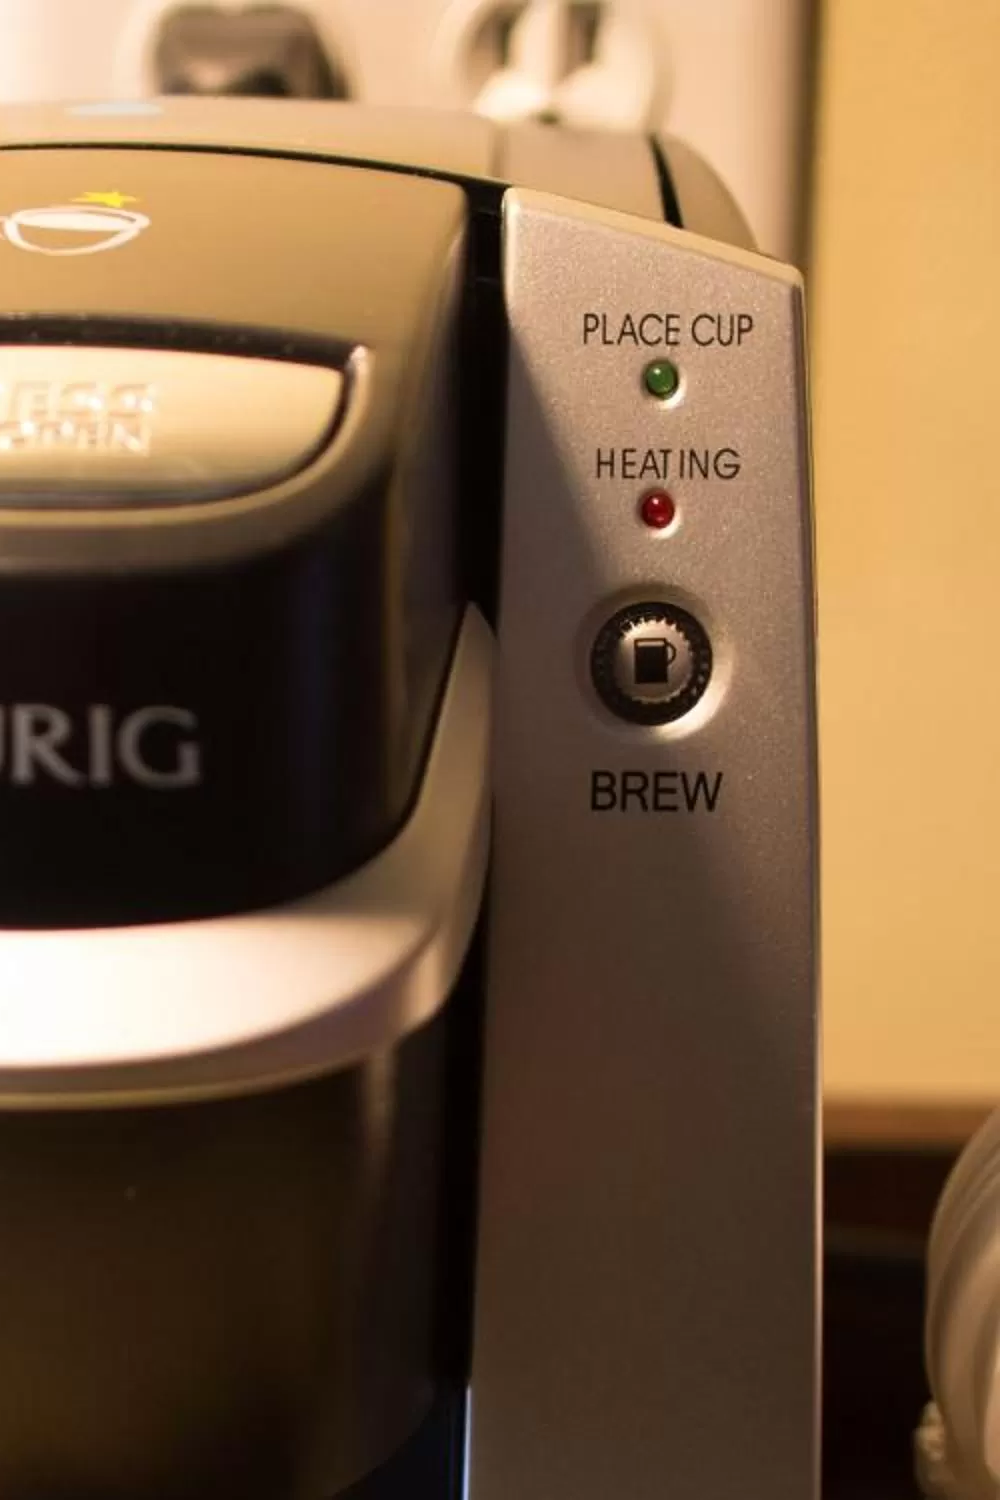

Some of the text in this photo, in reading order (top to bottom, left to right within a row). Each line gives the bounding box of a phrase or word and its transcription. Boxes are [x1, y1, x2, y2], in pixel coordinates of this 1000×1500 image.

[582, 313, 753, 347] PLACE CUP
[596, 447, 741, 481] HEATING
[590, 771, 723, 812] BREW
